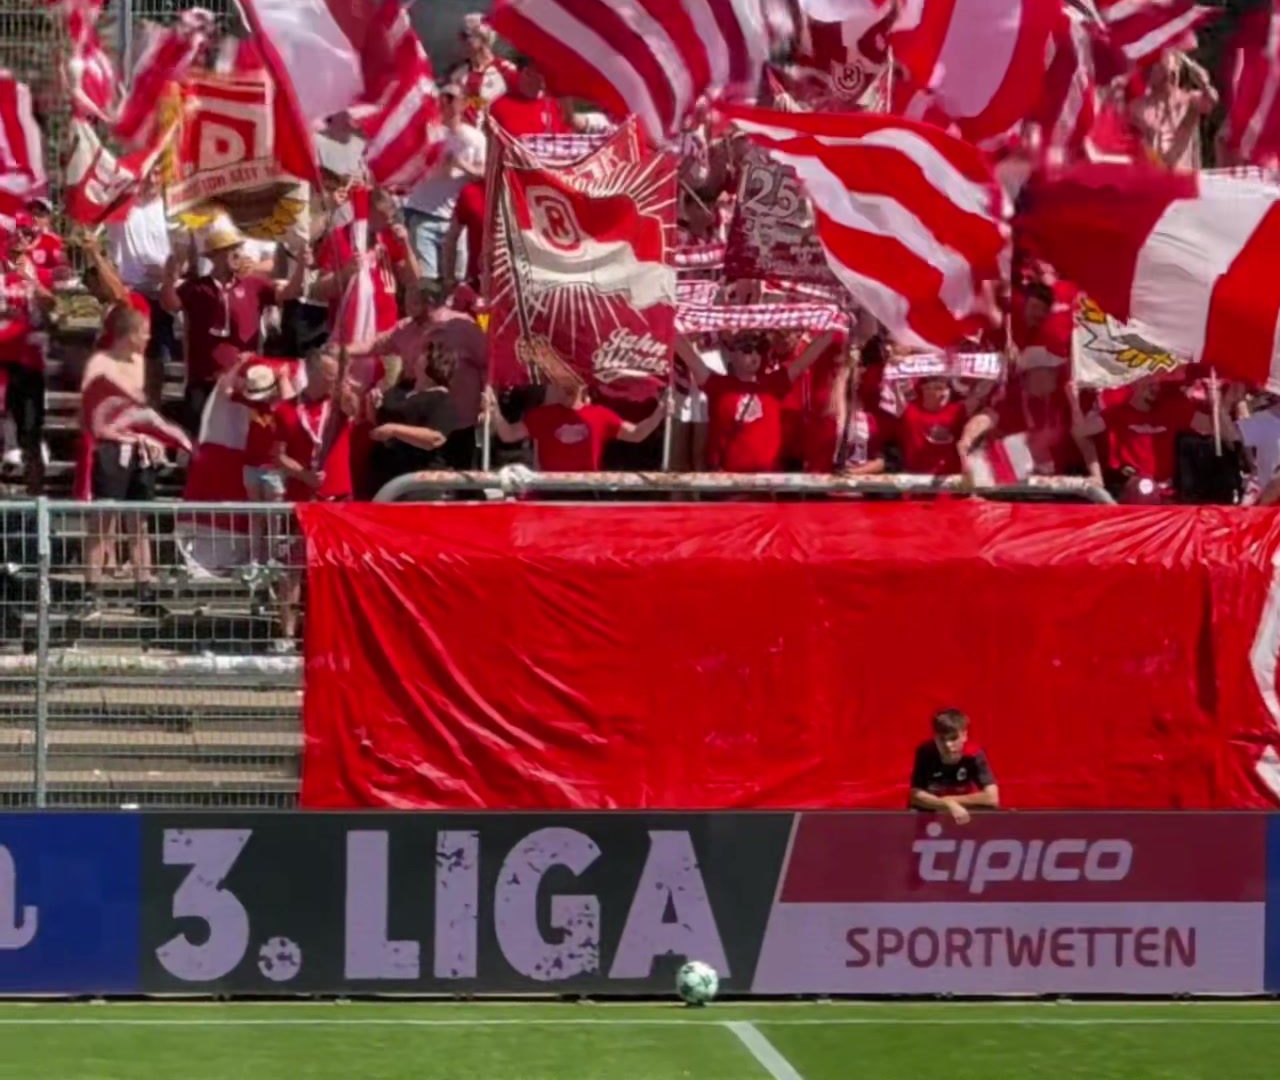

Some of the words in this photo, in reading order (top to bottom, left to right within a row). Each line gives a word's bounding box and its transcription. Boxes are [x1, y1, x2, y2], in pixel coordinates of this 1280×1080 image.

[912, 822, 1134, 894] tipico
[156, 827, 302, 982] 3.
[345, 826, 731, 981] LIGA
[845, 926, 1197, 968] SPORTWETTEN
